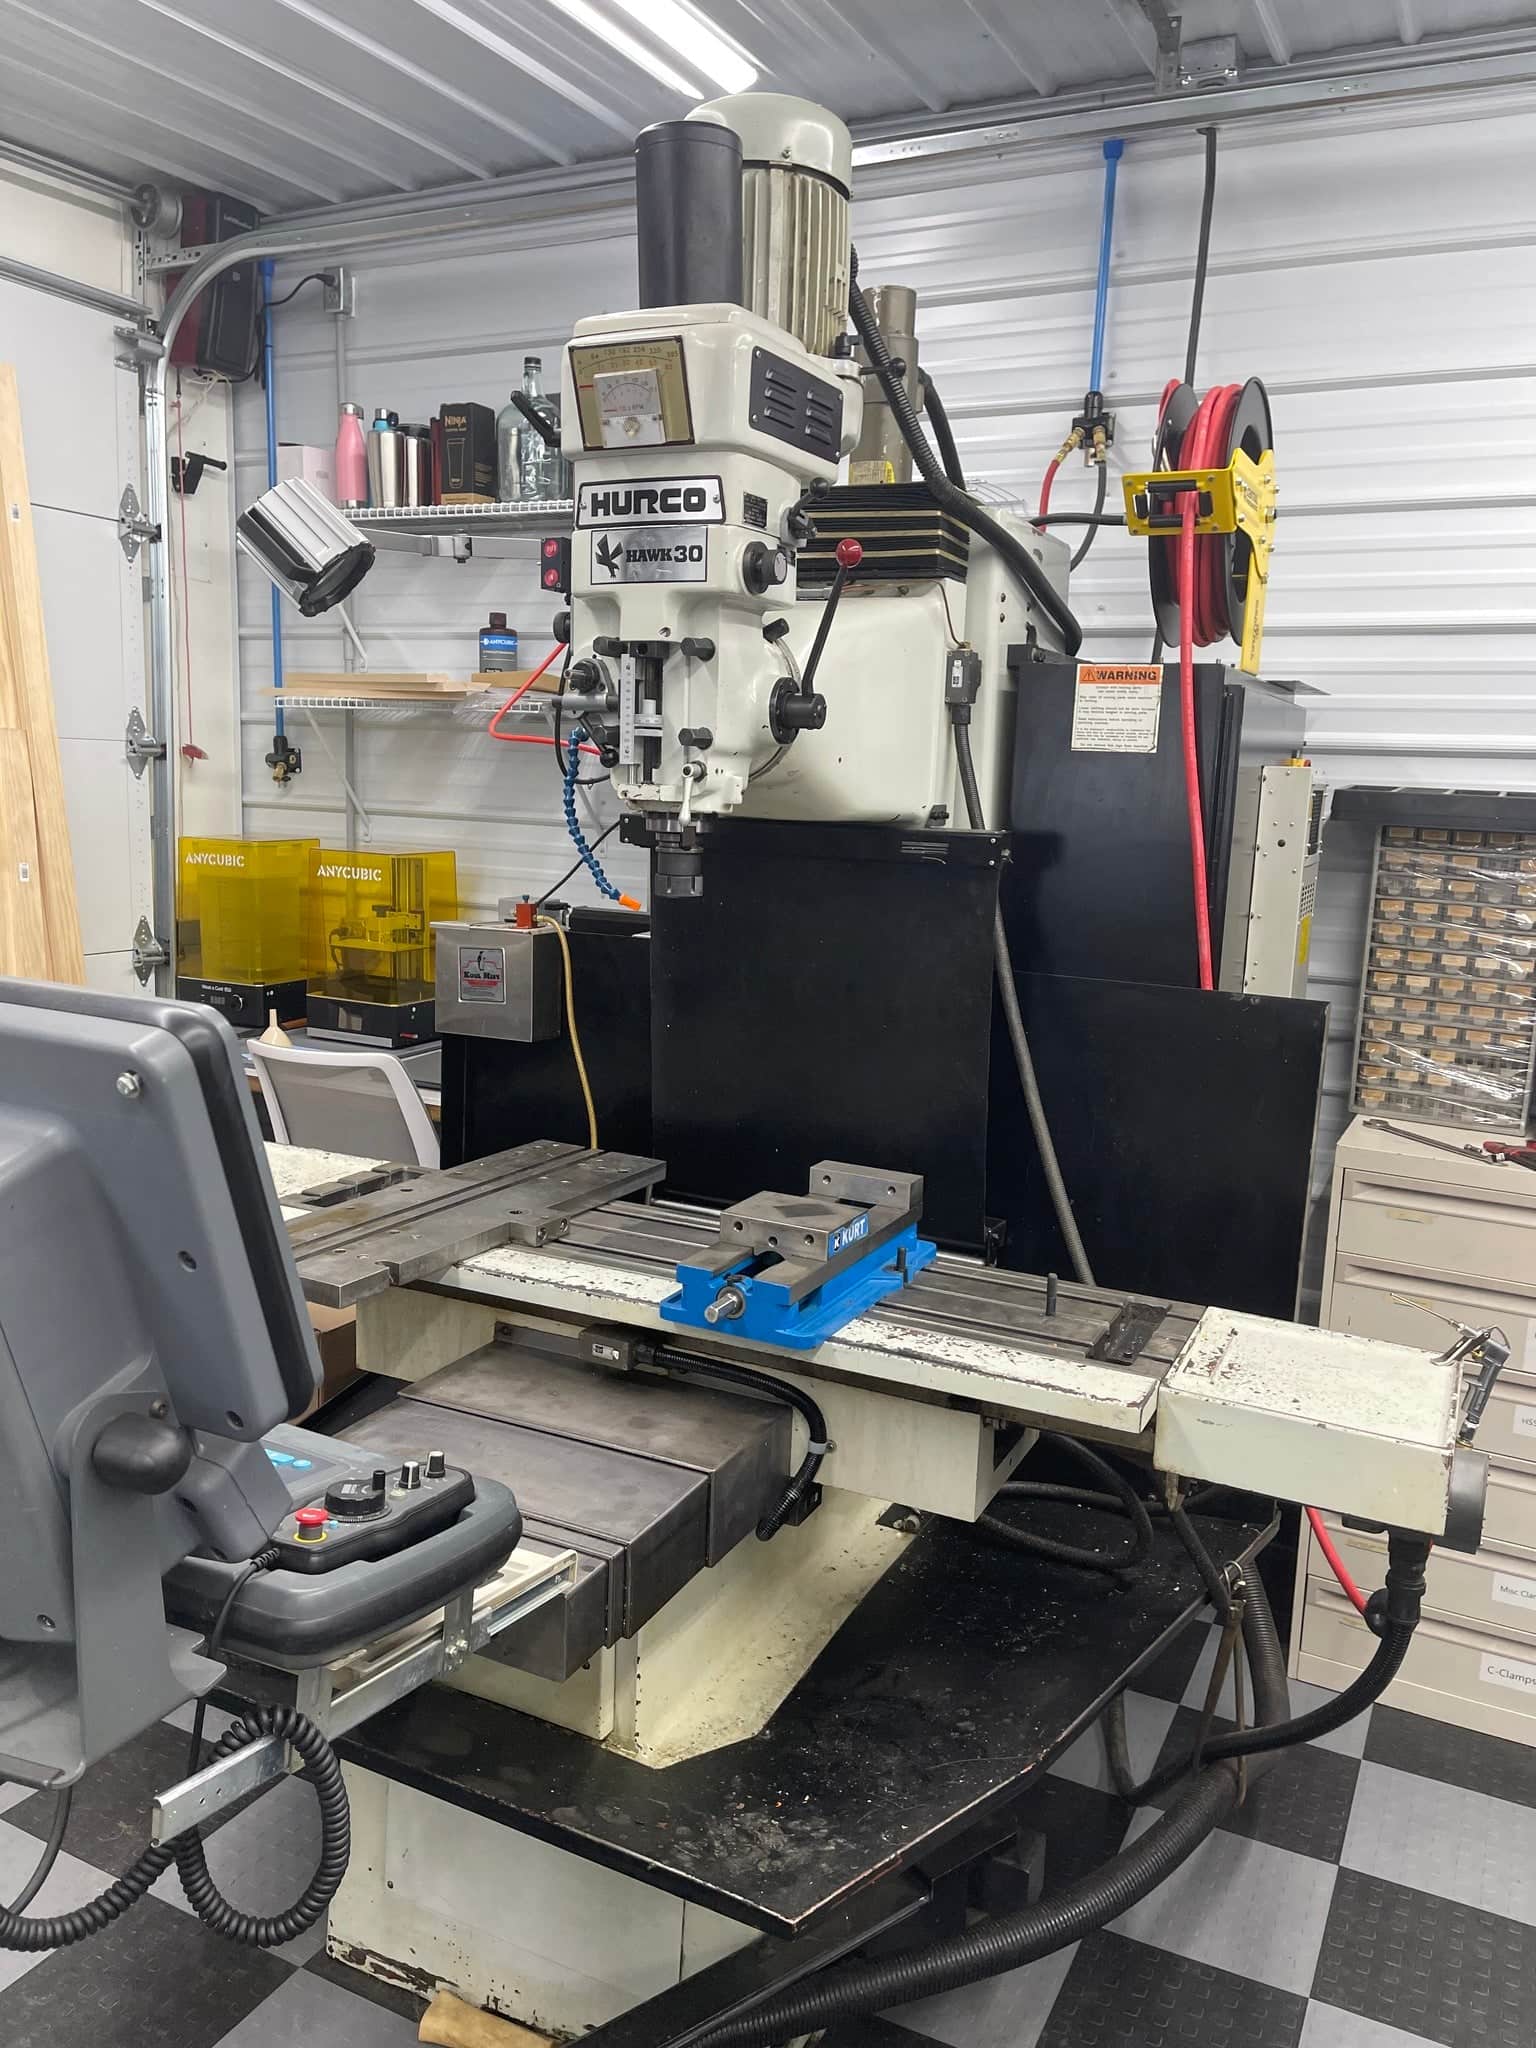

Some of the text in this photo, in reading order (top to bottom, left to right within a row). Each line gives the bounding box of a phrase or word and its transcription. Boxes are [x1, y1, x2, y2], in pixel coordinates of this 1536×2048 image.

[591, 487, 706, 517] HURCO
[1097, 670, 1157, 681] WARNING
[185, 852, 245, 868] ANYCUBIC
[317, 864, 382, 882] ANYCUBIC
[841, 1218, 866, 1246] KURT
